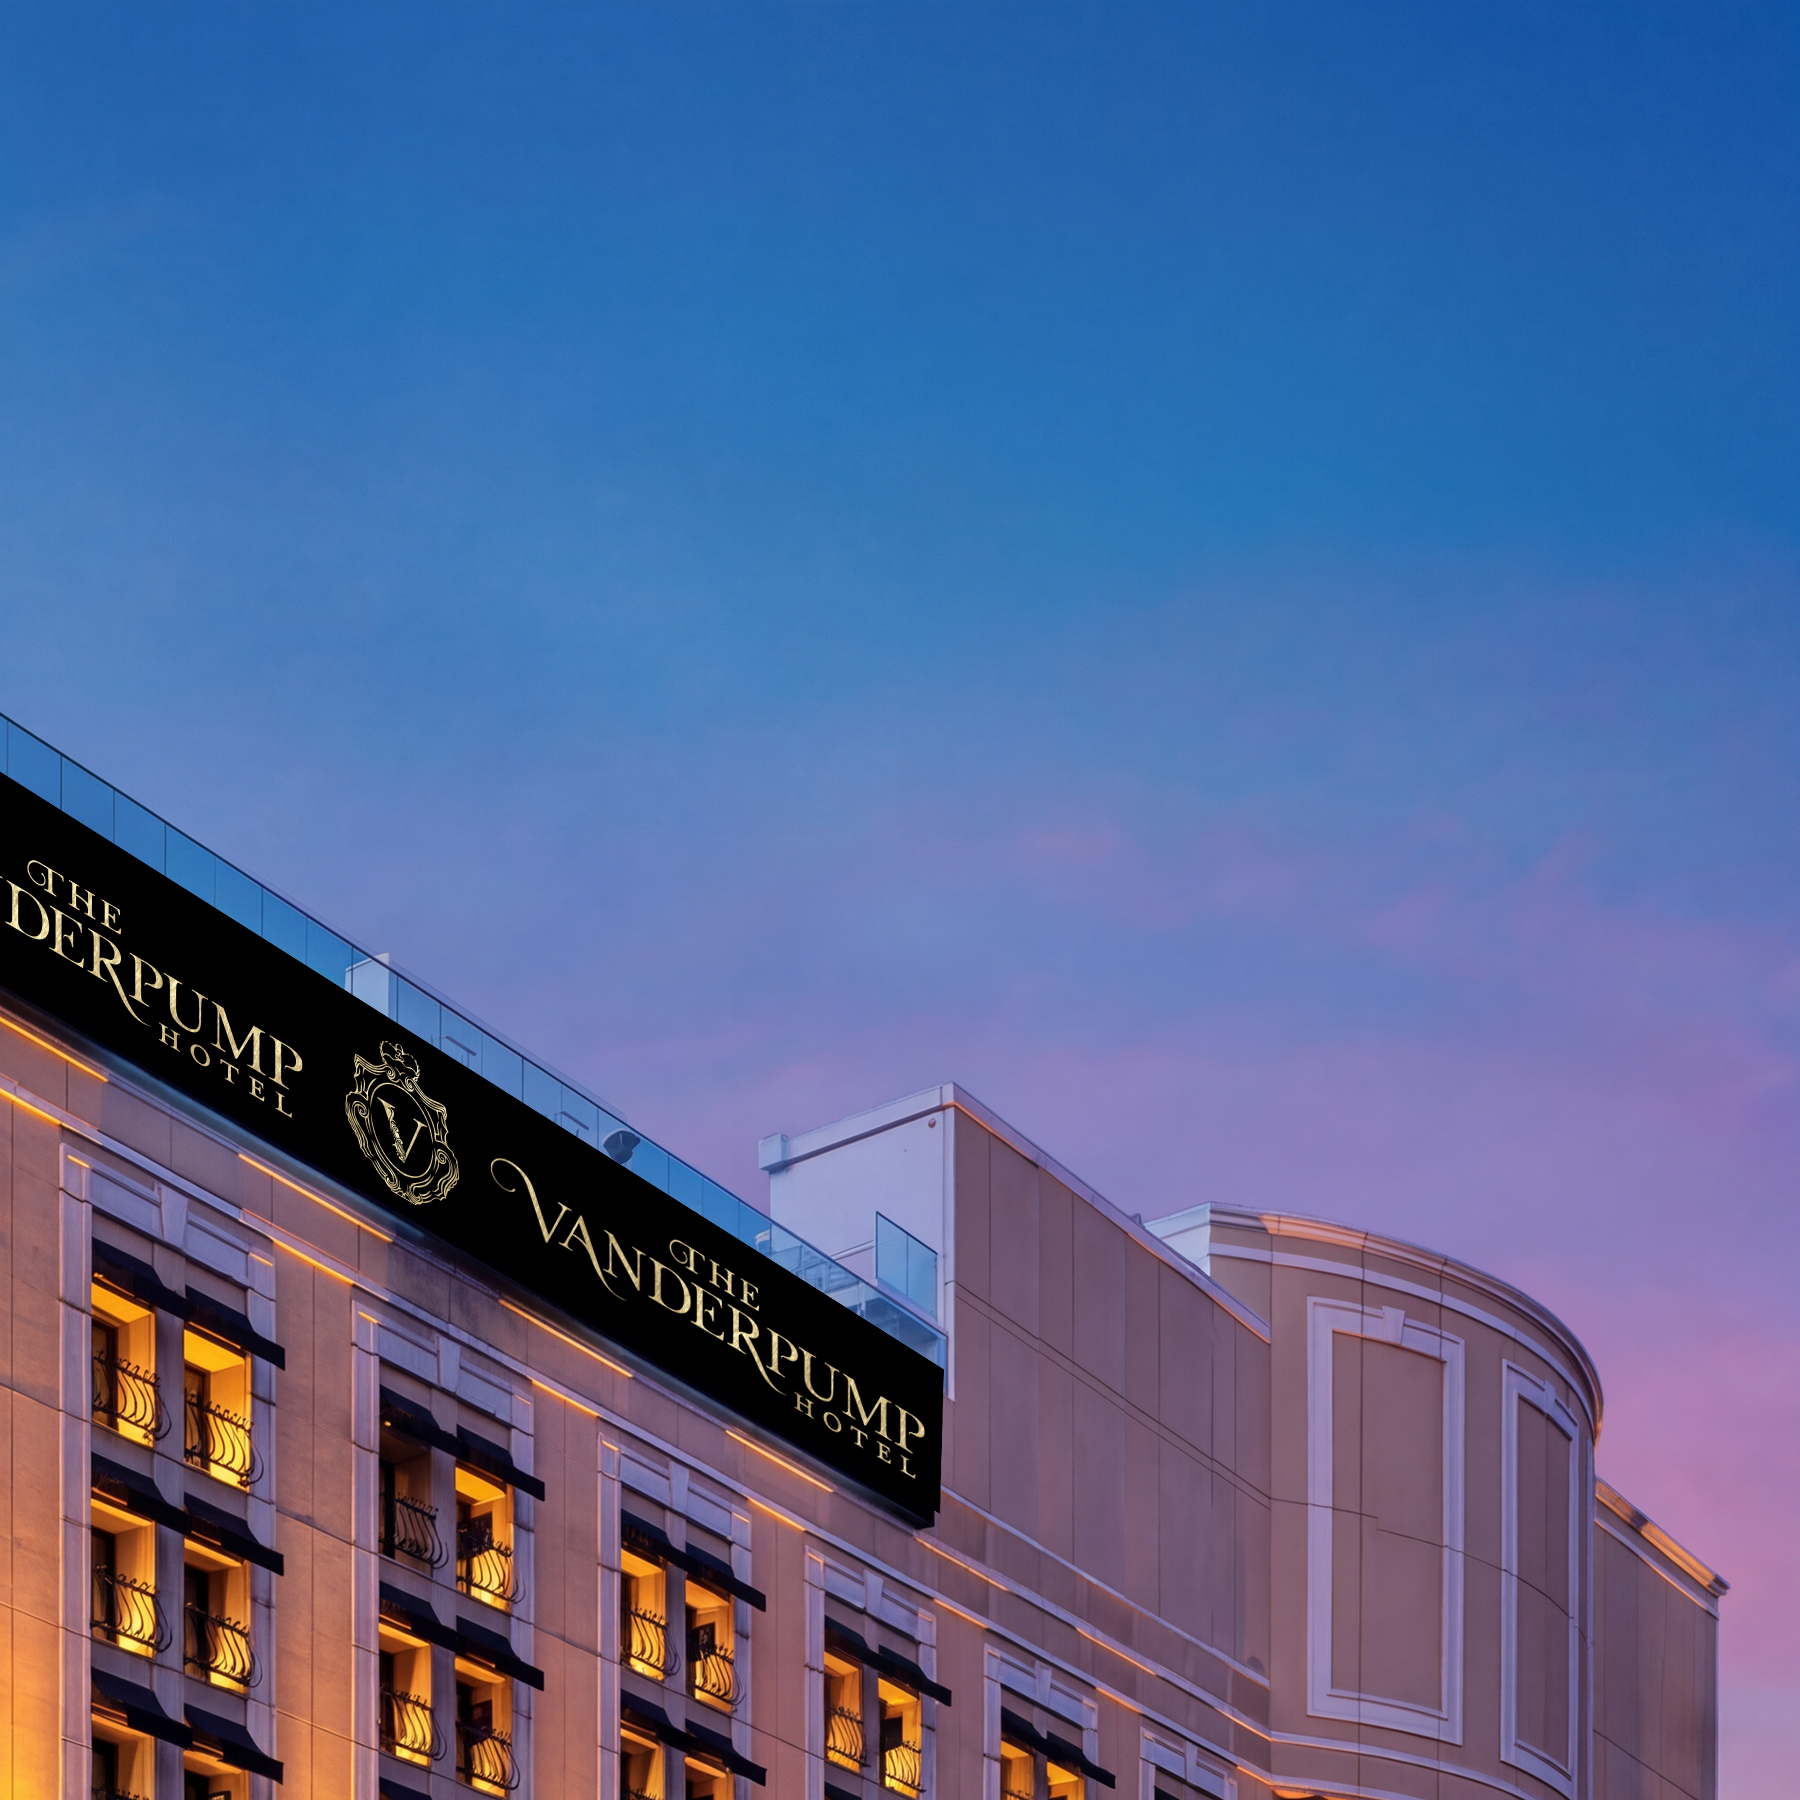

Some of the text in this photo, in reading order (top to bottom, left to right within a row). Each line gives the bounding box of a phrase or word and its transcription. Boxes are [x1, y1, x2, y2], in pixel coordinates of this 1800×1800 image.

[27, 860, 121, 935] THE
[158, 1023, 293, 1118] HOTEL
[377, 1097, 427, 1163] V
[491, 1158, 925, 1454] VANDERPUMP
[669, 1239, 759, 1311] THE
[794, 1391, 916, 1479] HOTEL
